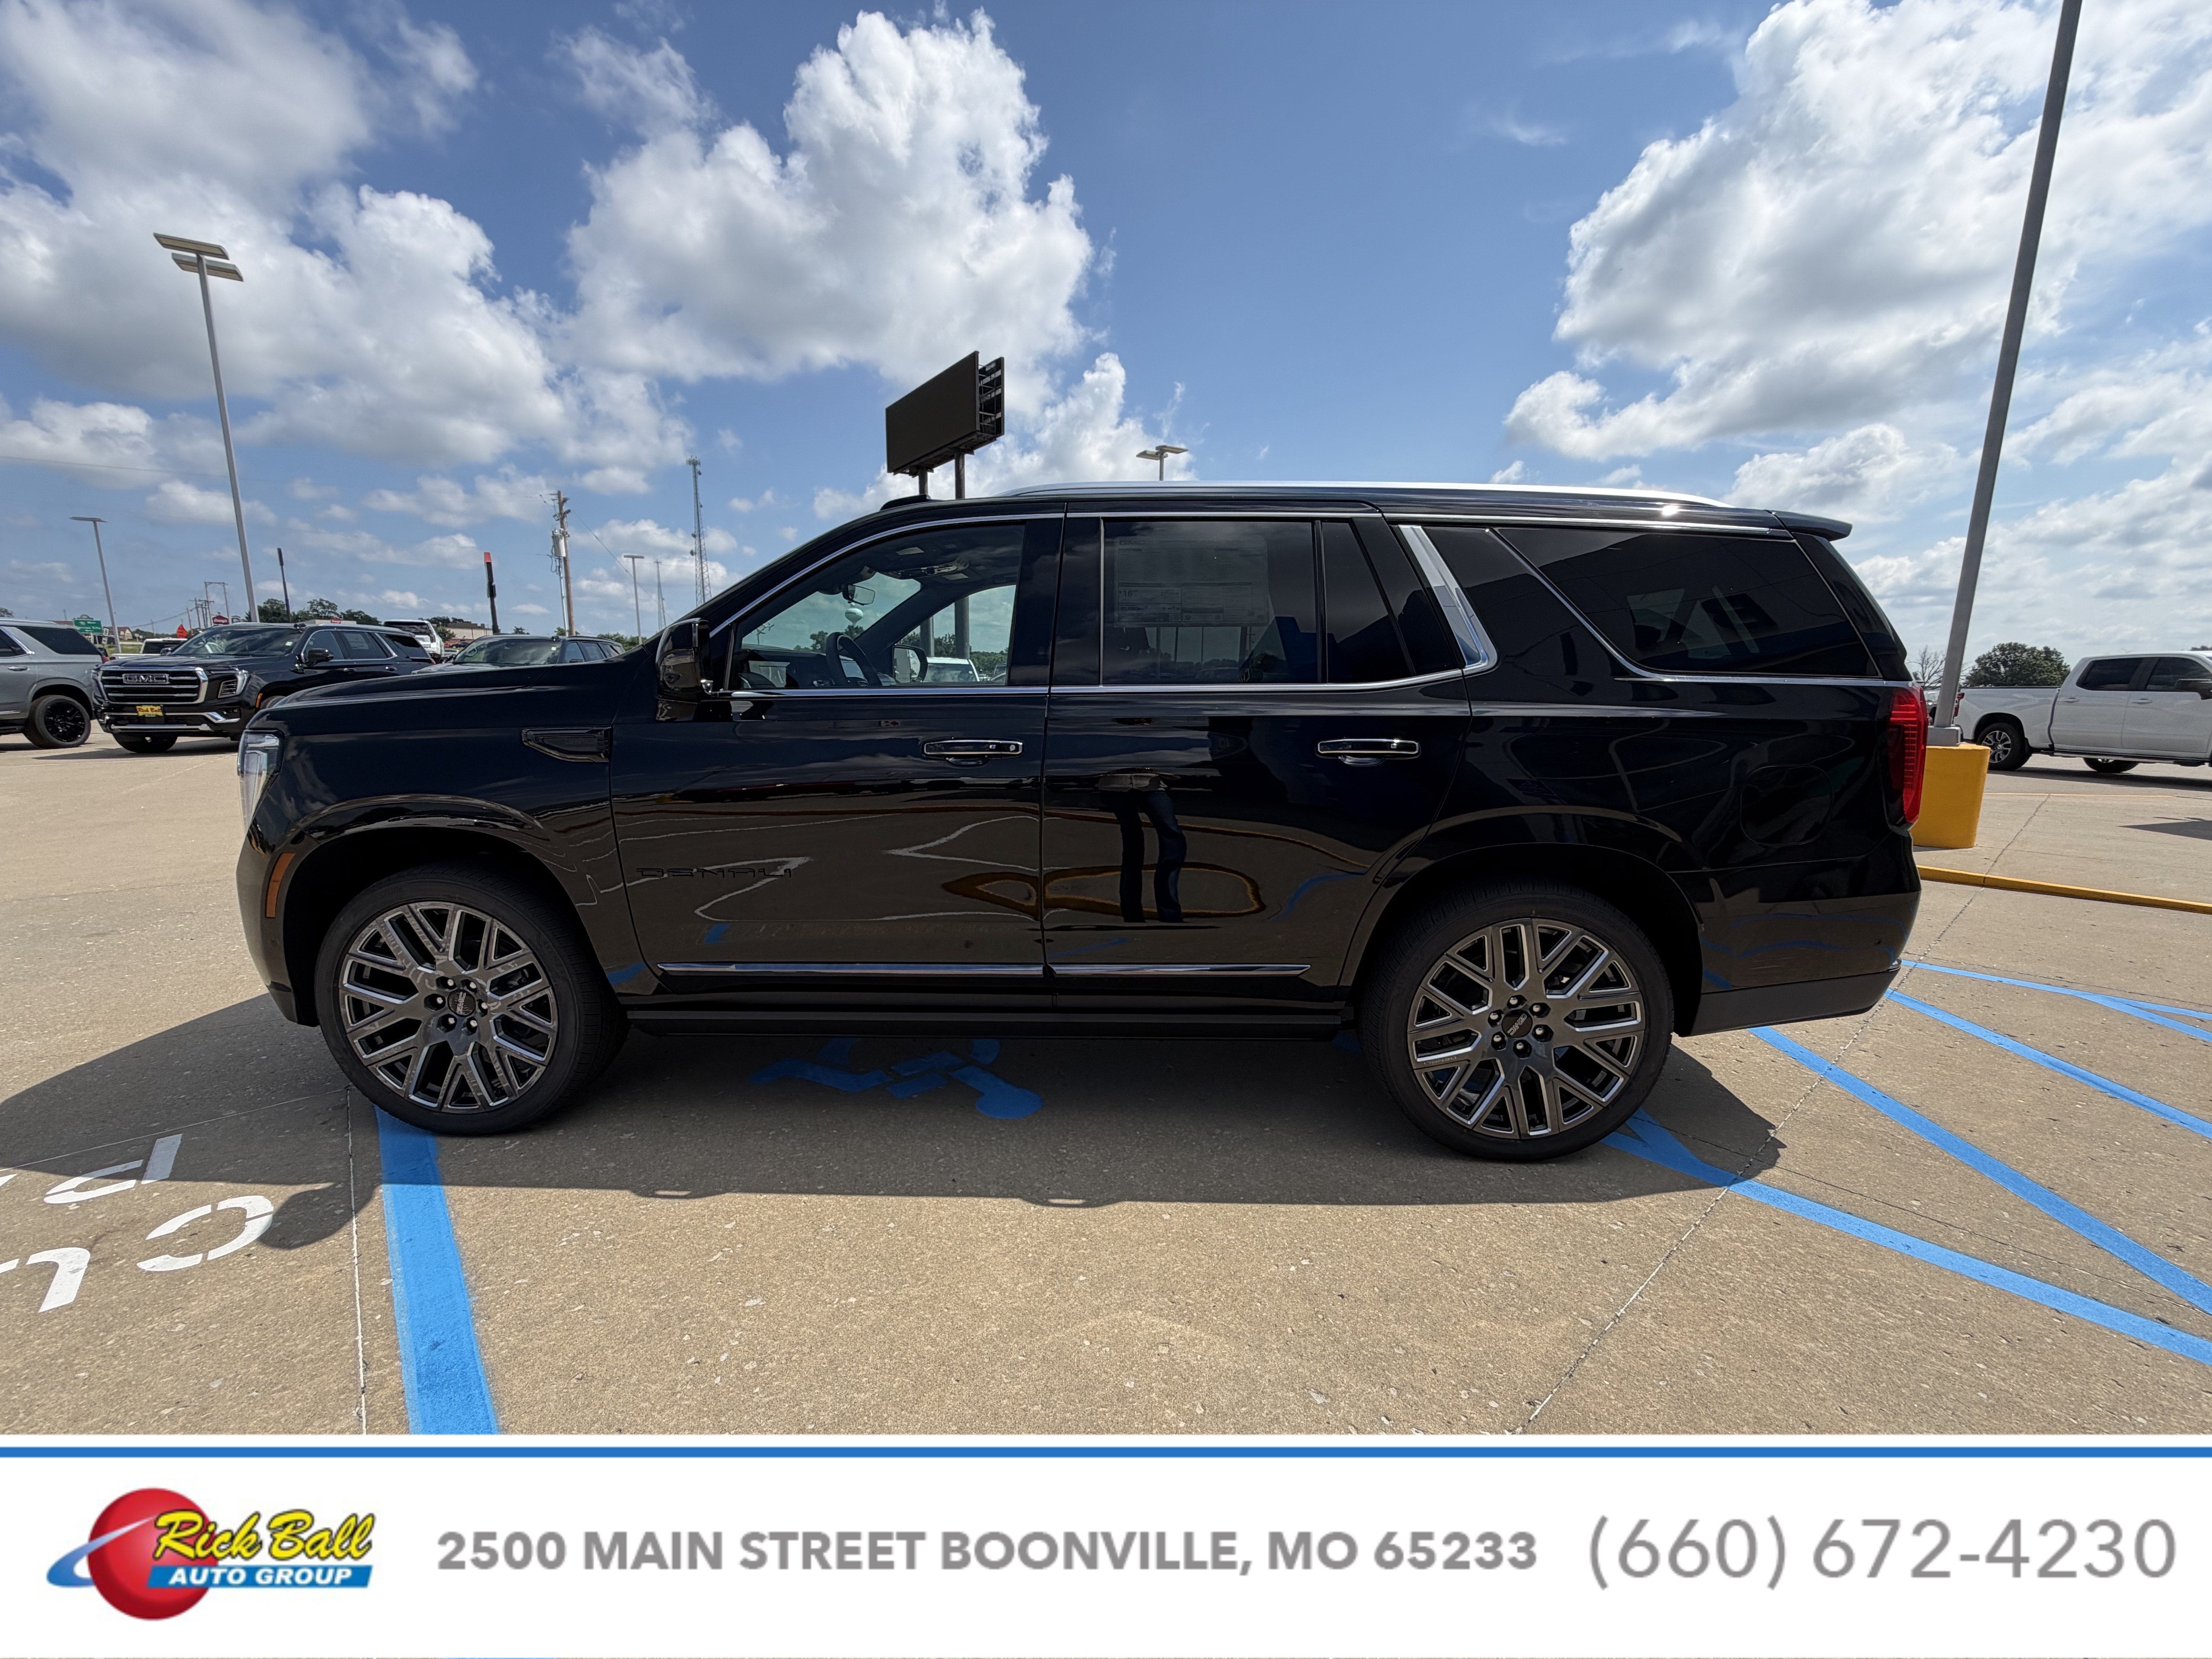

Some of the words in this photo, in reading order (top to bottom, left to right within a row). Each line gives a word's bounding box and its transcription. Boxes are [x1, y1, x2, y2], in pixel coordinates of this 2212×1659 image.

[636, 867, 792, 878] DENALI
[456, 991, 467, 1015] GMC
[1507, 1013, 1528, 1036] GMC
